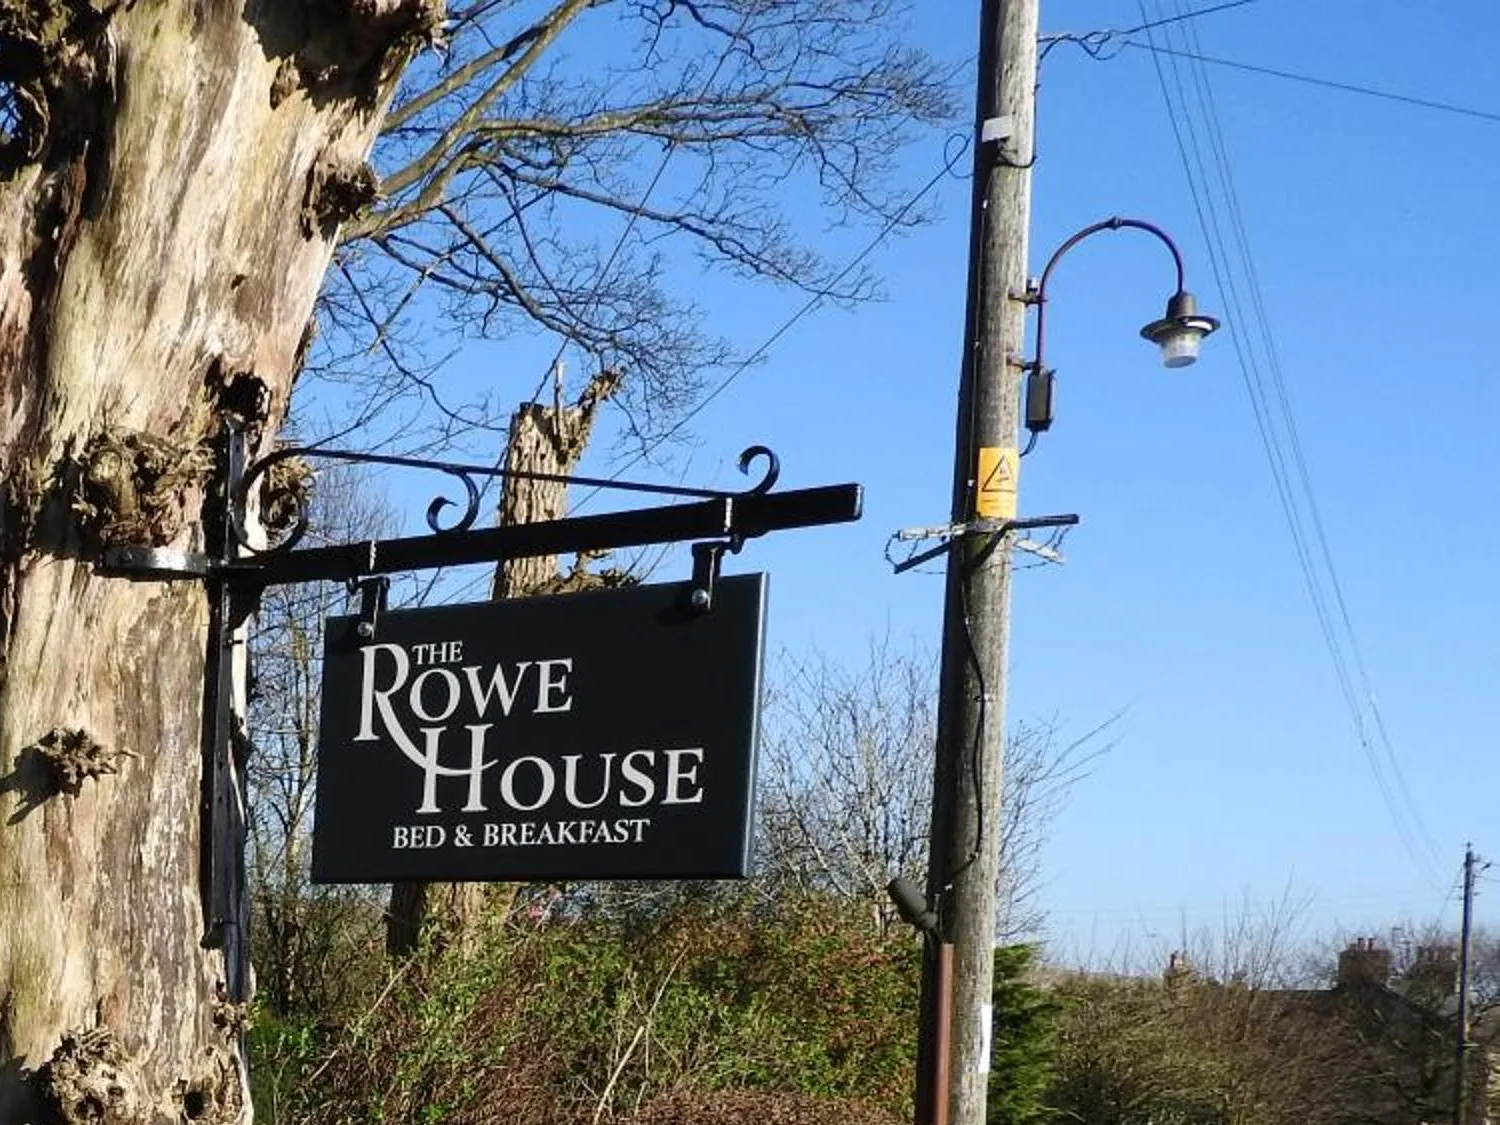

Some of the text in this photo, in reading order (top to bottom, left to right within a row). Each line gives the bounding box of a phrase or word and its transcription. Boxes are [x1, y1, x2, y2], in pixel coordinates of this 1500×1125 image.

[411, 640, 463, 664] THE
[352, 642, 573, 776] ROWE
[415, 723, 704, 813] HOUSE
[392, 818, 651, 850] BED & BREAKFAST
